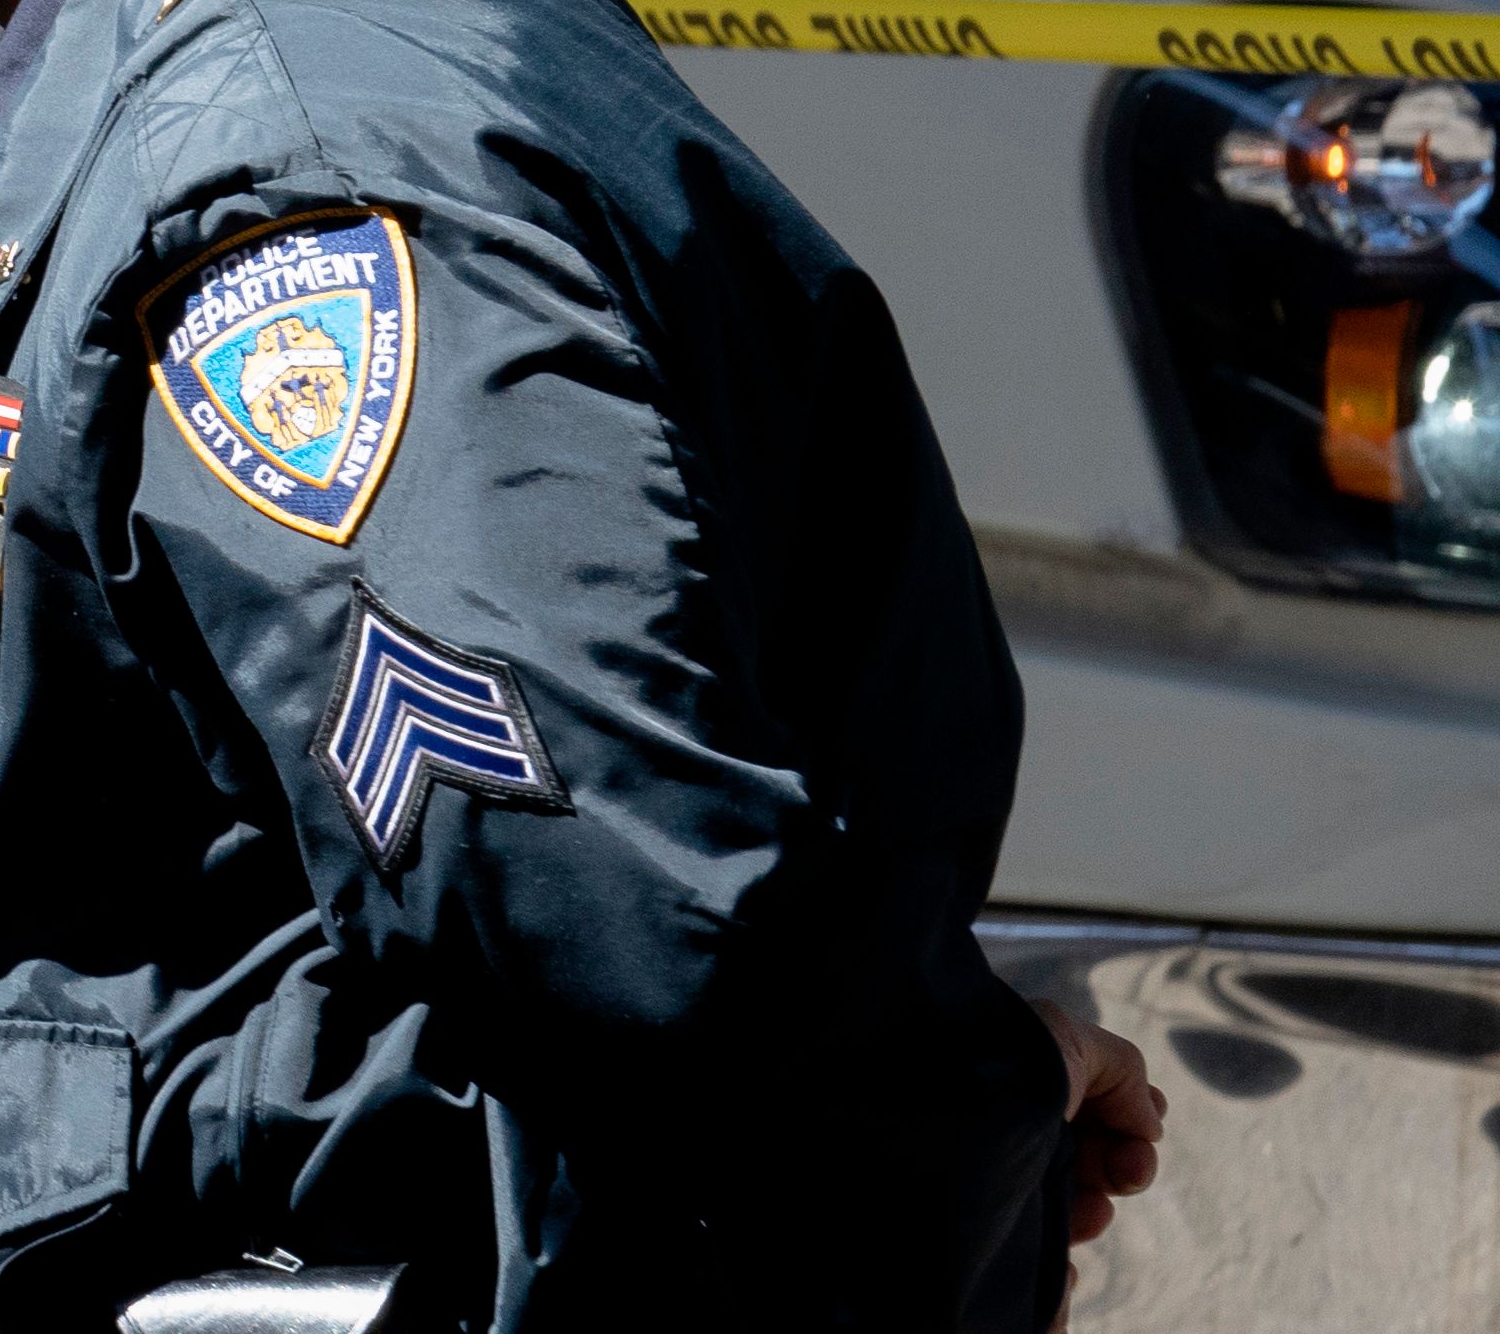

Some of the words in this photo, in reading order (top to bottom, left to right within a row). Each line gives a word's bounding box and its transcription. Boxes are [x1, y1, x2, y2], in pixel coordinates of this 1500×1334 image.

[168, 252, 379, 364] DEPARTMENT
[202, 229, 322, 299] POLICE
[191, 401, 252, 467] CITY
[253, 463, 298, 497] OF
[338, 415, 382, 488] NEW
[366, 309, 399, 402] YORK
